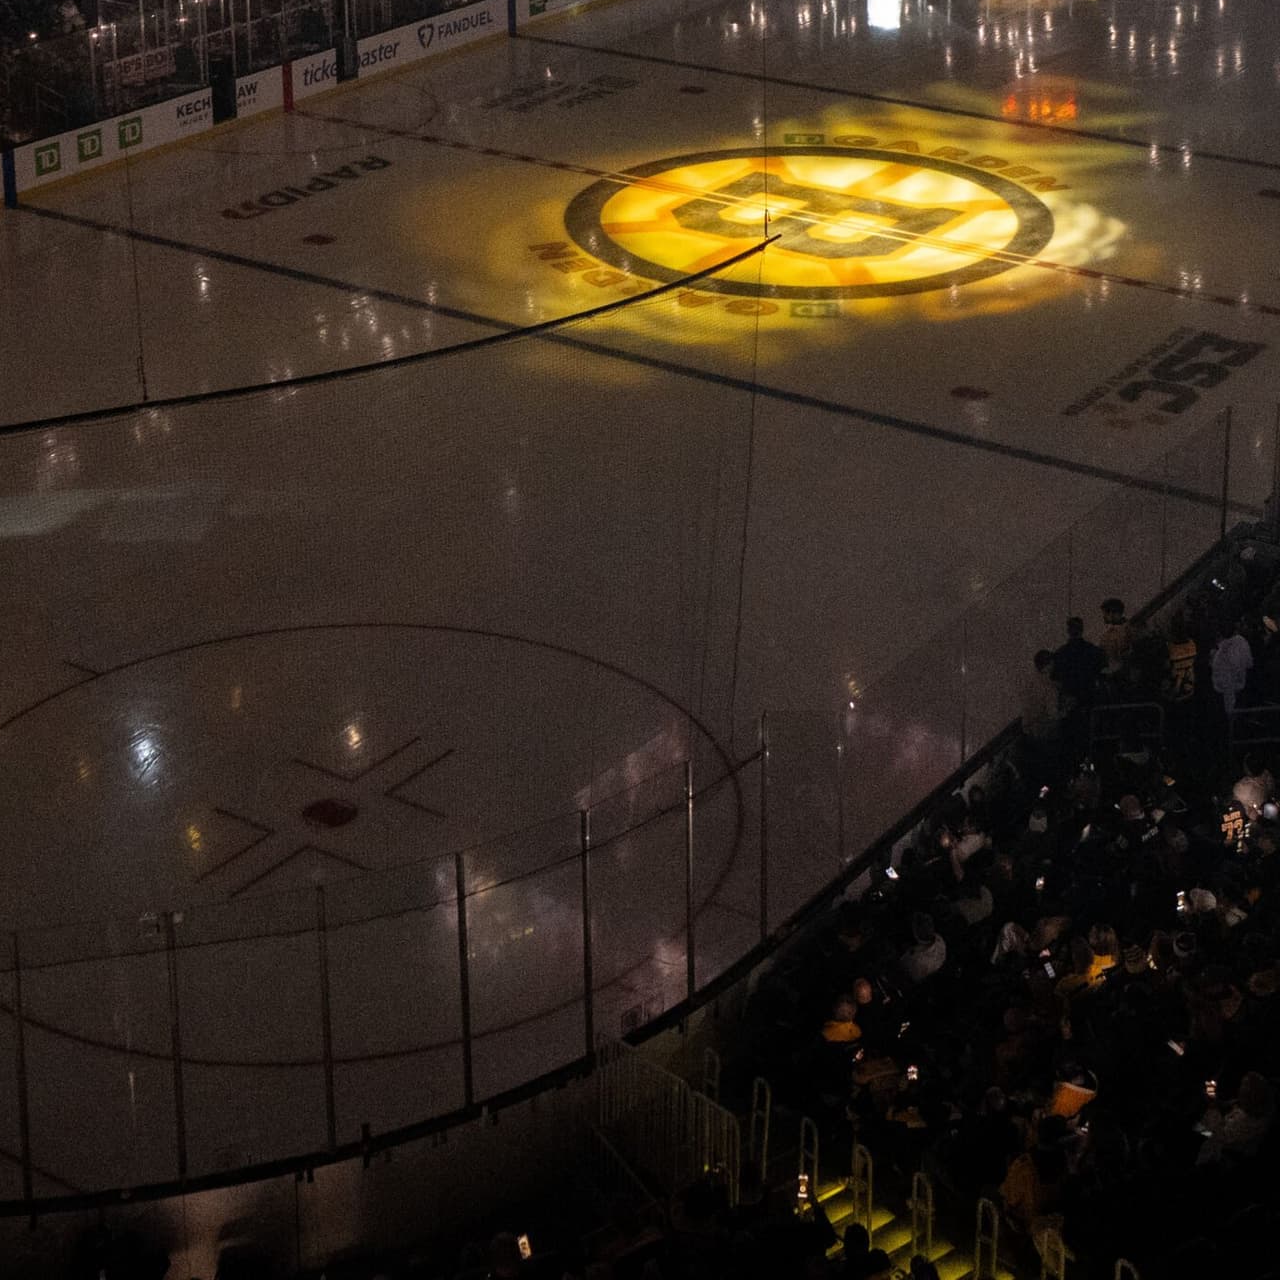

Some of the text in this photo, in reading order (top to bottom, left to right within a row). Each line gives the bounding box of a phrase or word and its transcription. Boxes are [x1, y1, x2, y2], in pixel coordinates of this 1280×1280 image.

[437, 10, 494, 40] FANDUEL
[176, 97, 212, 119] KECH
[832, 134, 1075, 193] GARDEN
